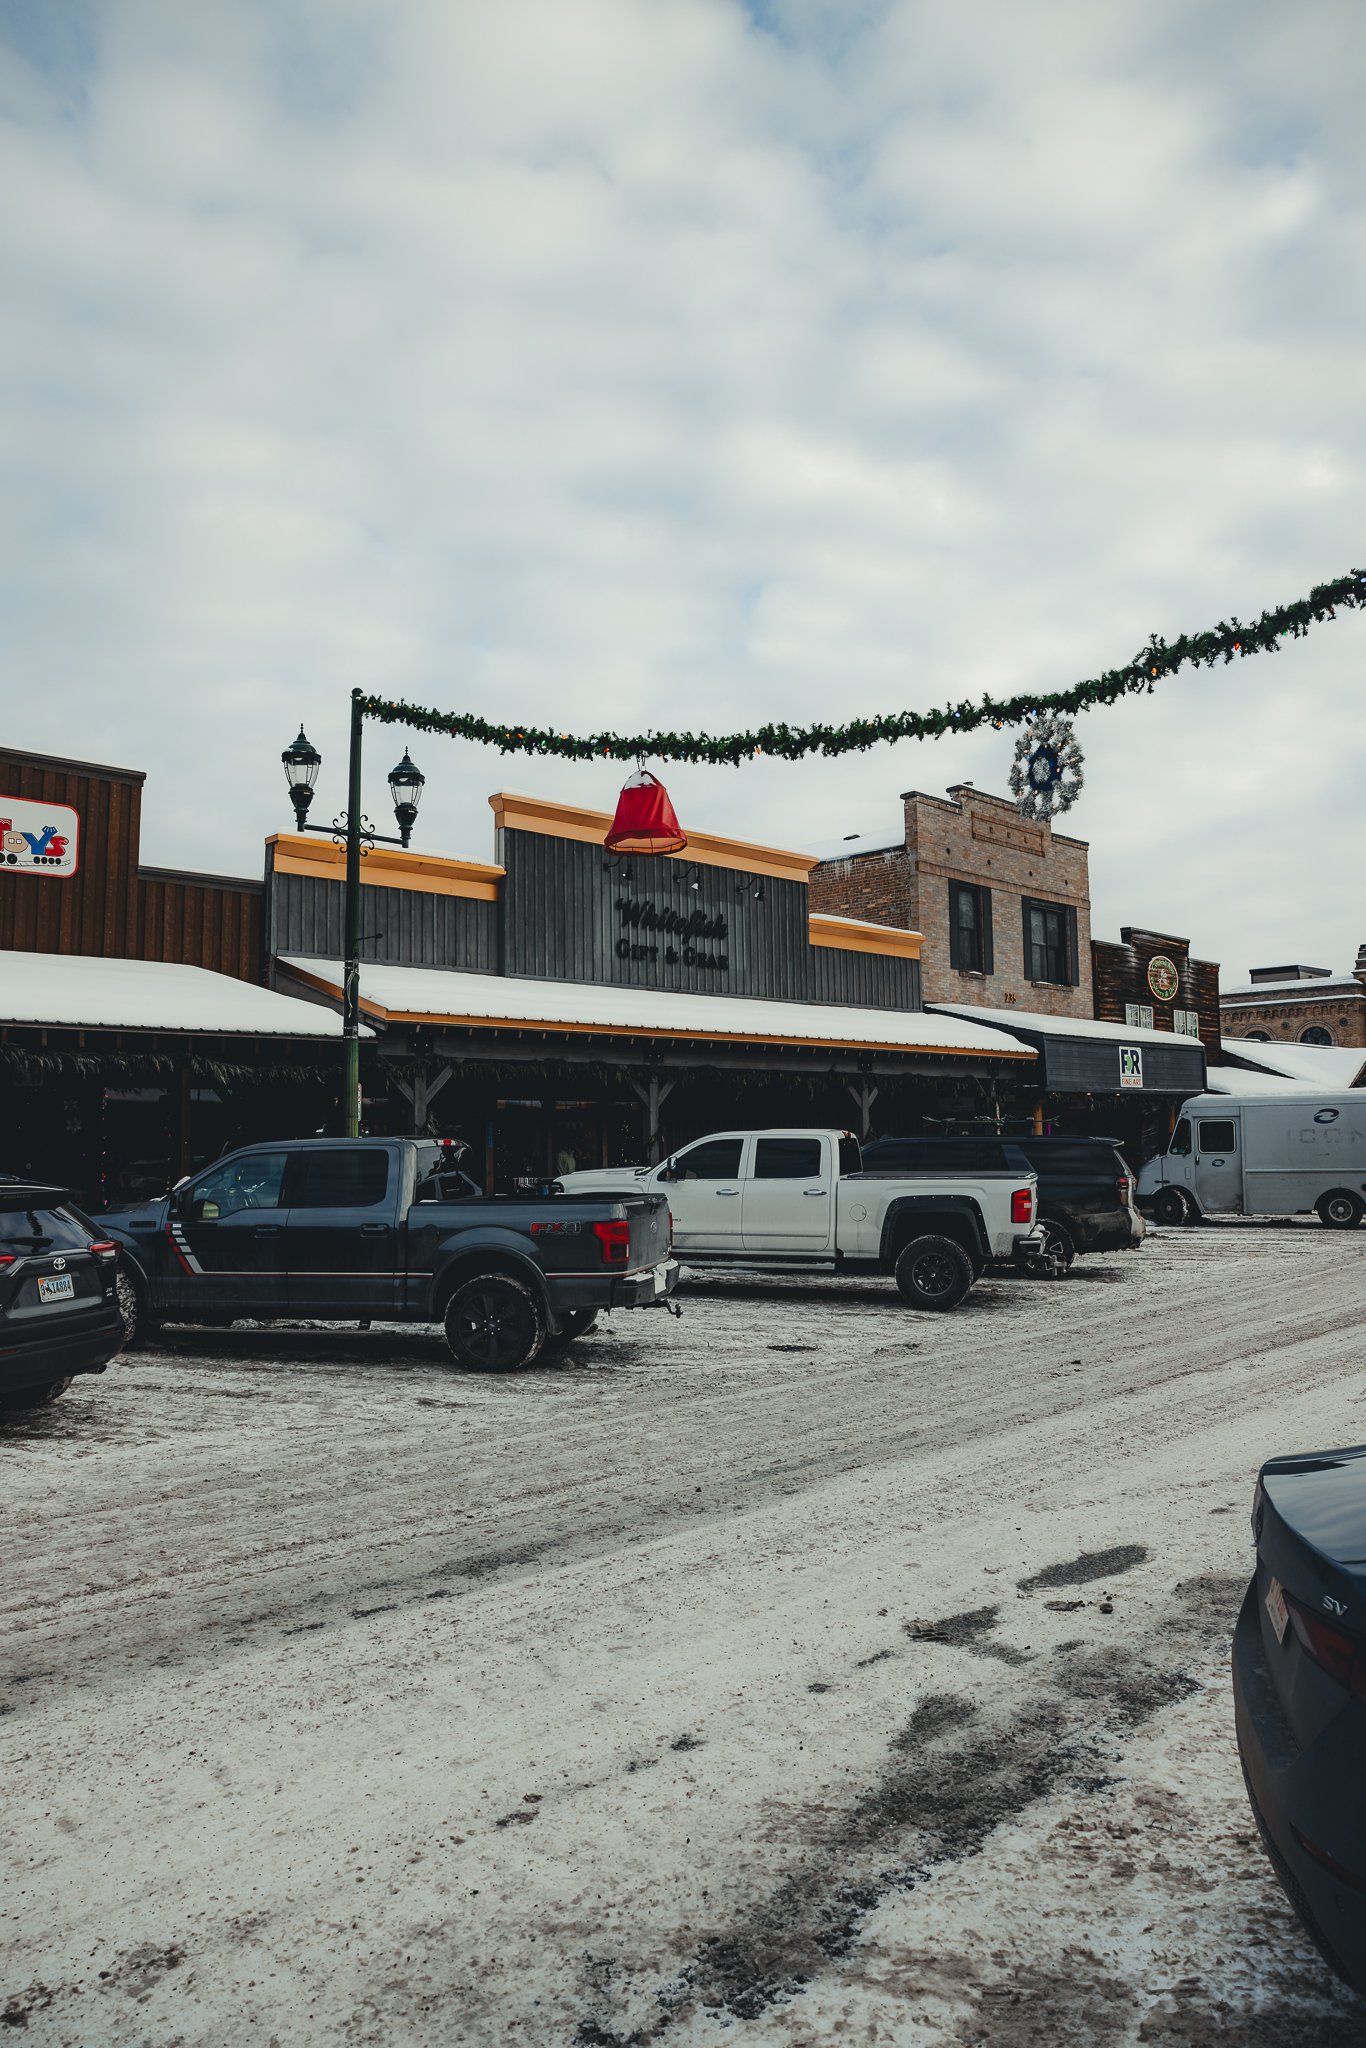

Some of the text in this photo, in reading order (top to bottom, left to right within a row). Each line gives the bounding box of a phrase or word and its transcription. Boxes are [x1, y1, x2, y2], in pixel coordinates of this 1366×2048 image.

[614, 898, 728, 945] Whitefish
[616, 939, 729, 971] GIFT & GEAR
[1121, 1078, 1142, 1086] FINE ART
[530, 1221, 581, 1235] FX4
[1322, 1595, 1348, 1616] SV
